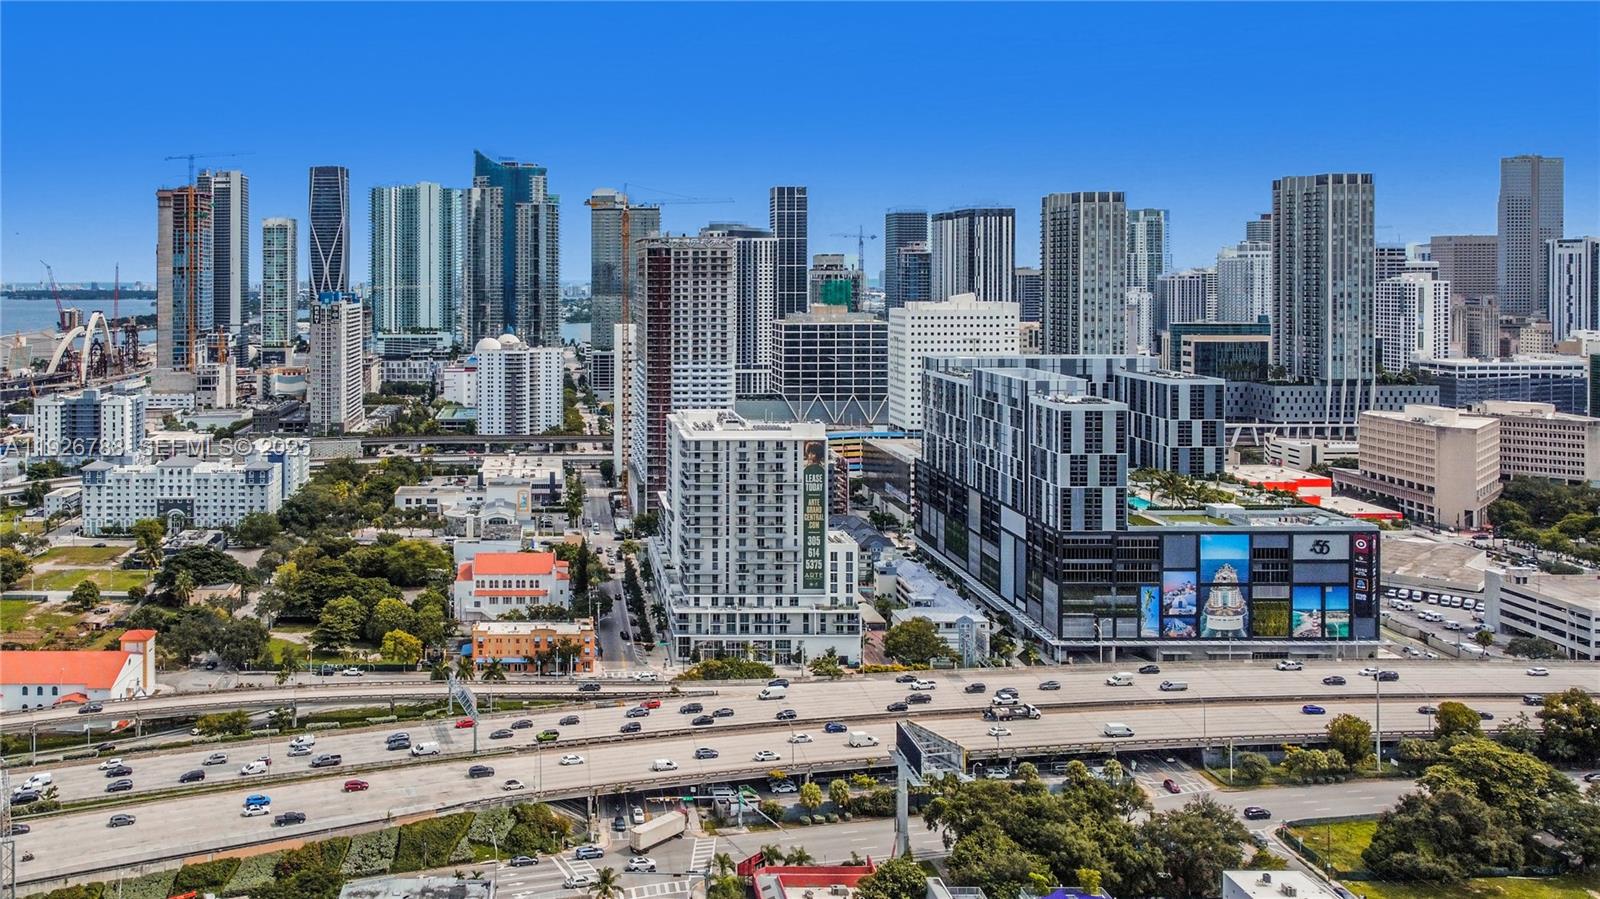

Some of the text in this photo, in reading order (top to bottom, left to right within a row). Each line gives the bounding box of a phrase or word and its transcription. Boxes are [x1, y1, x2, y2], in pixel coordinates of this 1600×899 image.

[805, 474, 823, 483] LEASE
[805, 483, 823, 492] TODAY
[807, 536, 820, 546] 305
[807, 547, 820, 557] 614
[805, 559, 823, 569] 5375
